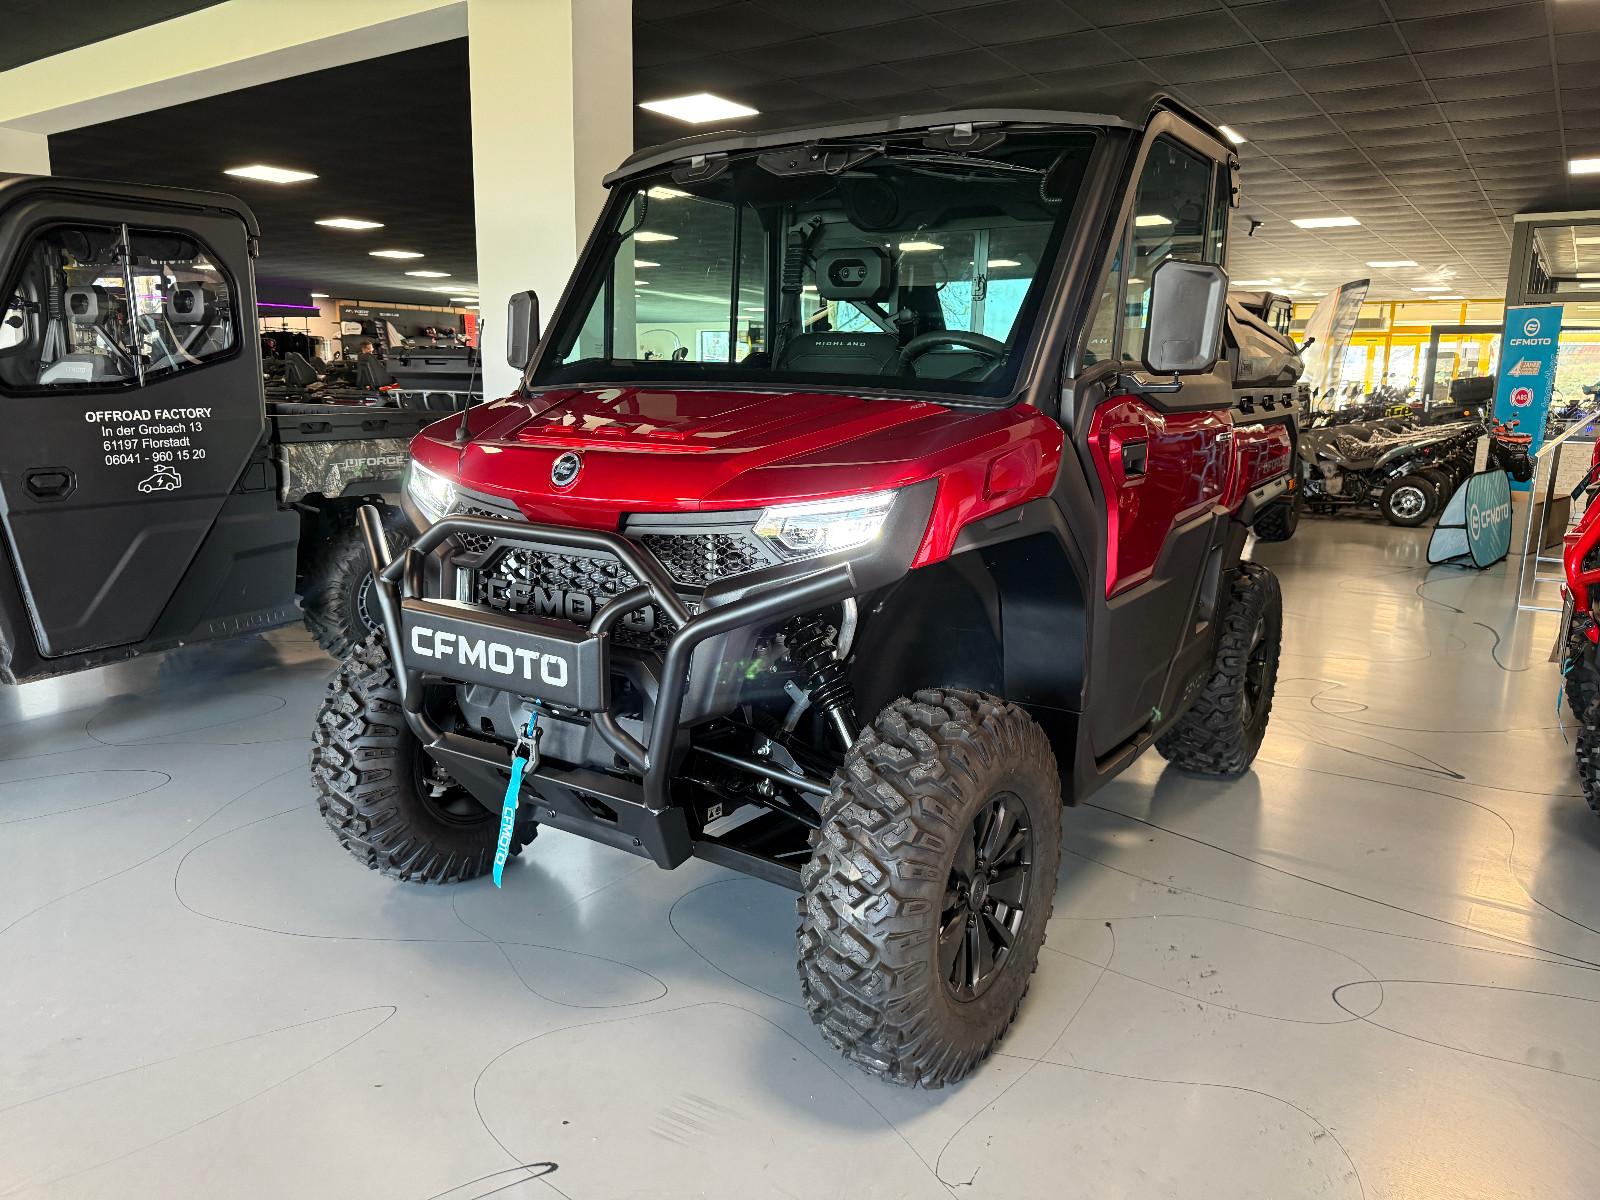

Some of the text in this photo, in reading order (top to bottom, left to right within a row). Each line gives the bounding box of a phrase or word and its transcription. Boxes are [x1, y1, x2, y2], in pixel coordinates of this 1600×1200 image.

[1510, 338, 1551, 346] CFMOTO
[85, 407, 212, 423] OFFROAD FACTORY
[101, 421, 203, 437] In der Grobach 13
[103, 436, 191, 452] 61197 Florstadt
[105, 453, 141, 466] 06041
[152, 451, 173, 463] 960
[177, 449, 190, 461] 15
[192, 448, 206, 460] 20
[345, 455, 405, 469] UFORCE
[1481, 504, 1509, 528] CFMOTO
[487, 578, 654, 633] CFMOO
[411, 625, 568, 687] CFMOTO
[496, 807, 514, 864] CFMOTO
